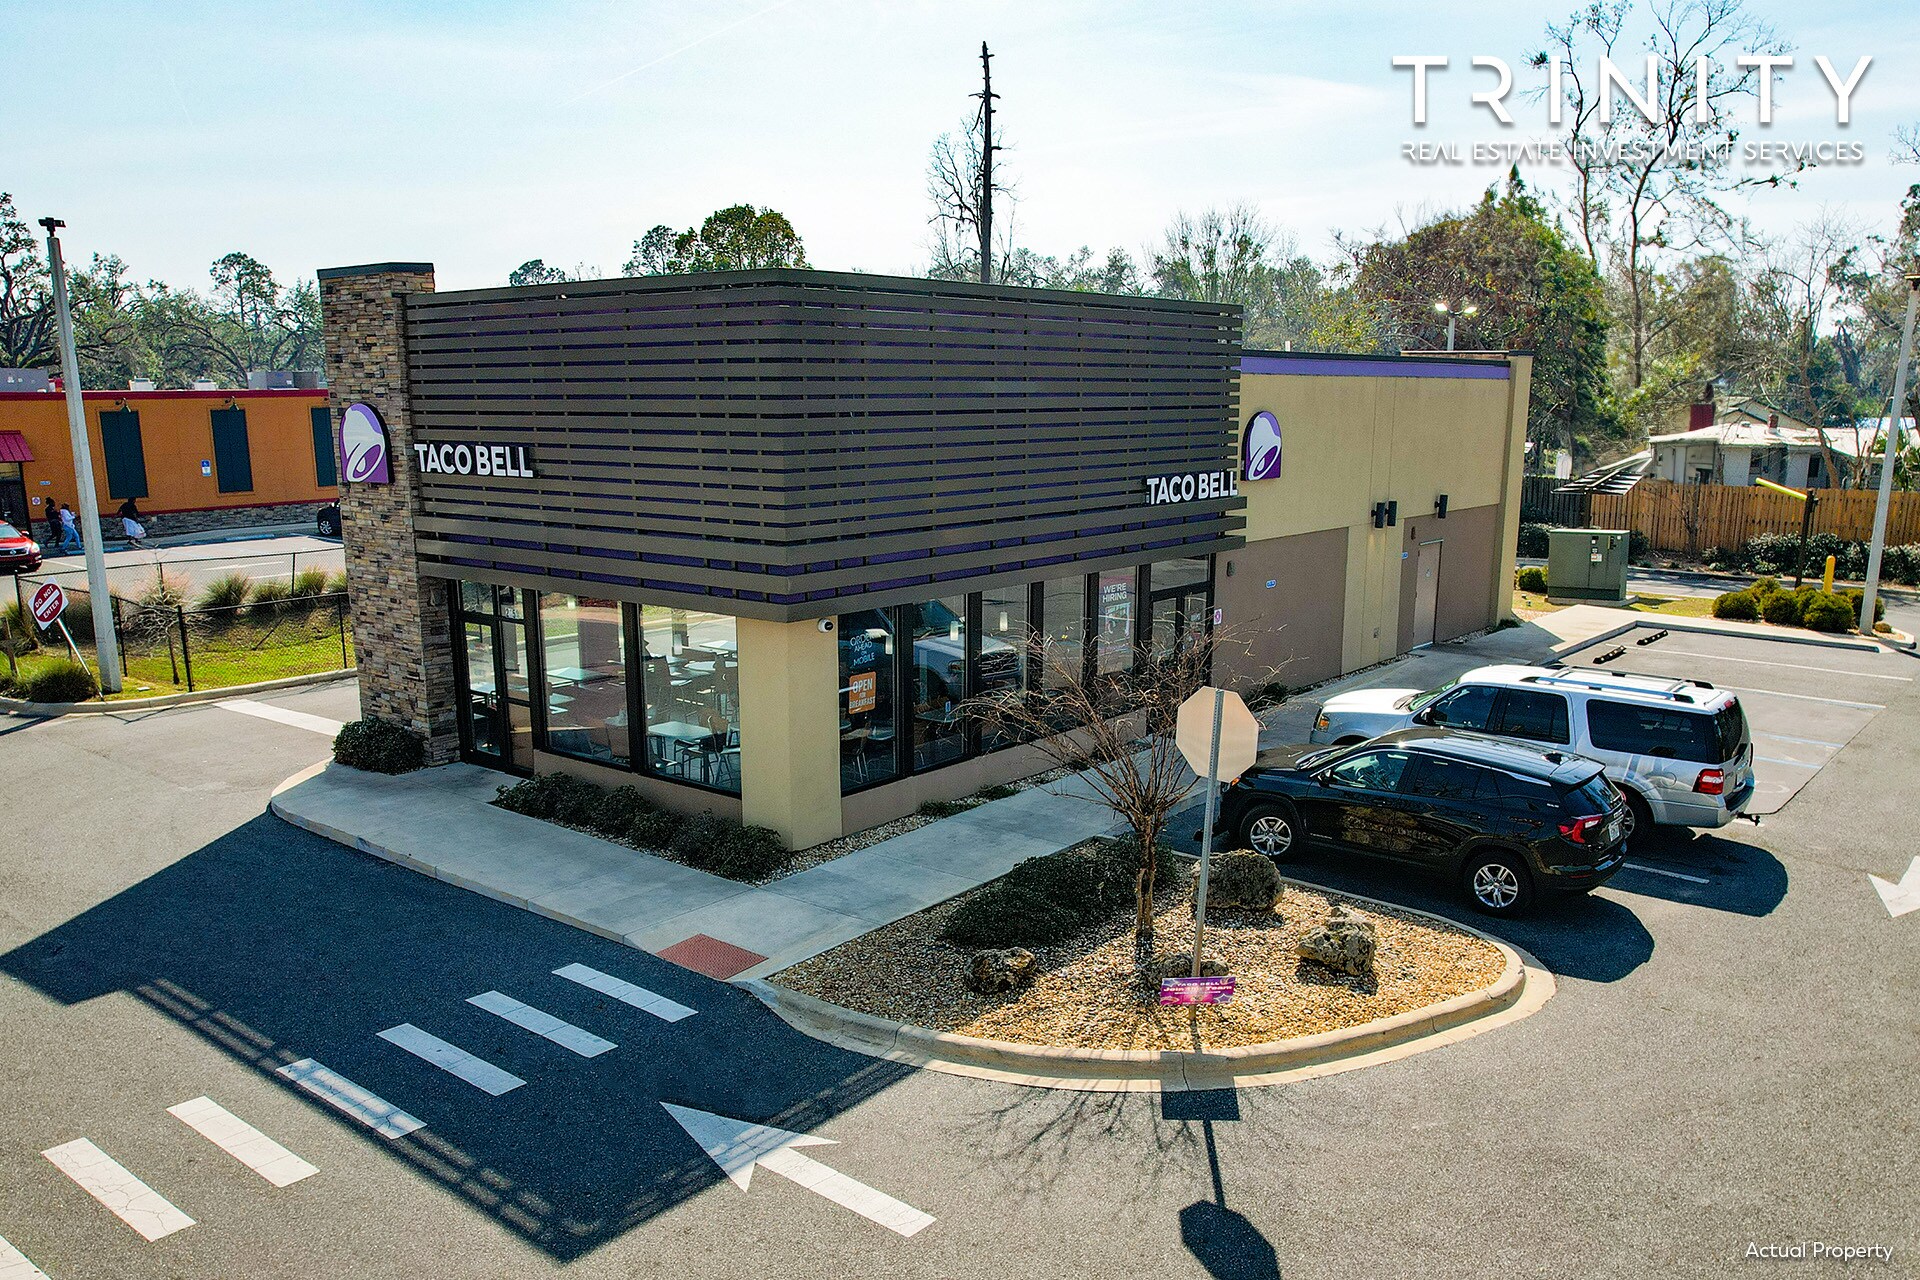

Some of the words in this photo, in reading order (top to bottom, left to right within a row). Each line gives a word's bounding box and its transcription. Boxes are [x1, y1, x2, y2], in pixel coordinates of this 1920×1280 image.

[414, 443, 472, 475] TACO
[475, 445, 534, 478] BELL
[1146, 474, 1195, 505] TACO
[1198, 471, 1238, 500] BELL
[1103, 583, 1127, 593] WE'RE
[34, 598, 43, 608] DO
[43, 585, 54, 599] NOT
[1102, 591, 1127, 603] HIRING
[43, 600, 59, 618] ENTER
[854, 641, 872, 652] AHEAD
[853, 652, 875, 666] MOBILE
[852, 678, 873, 693] OPEN
